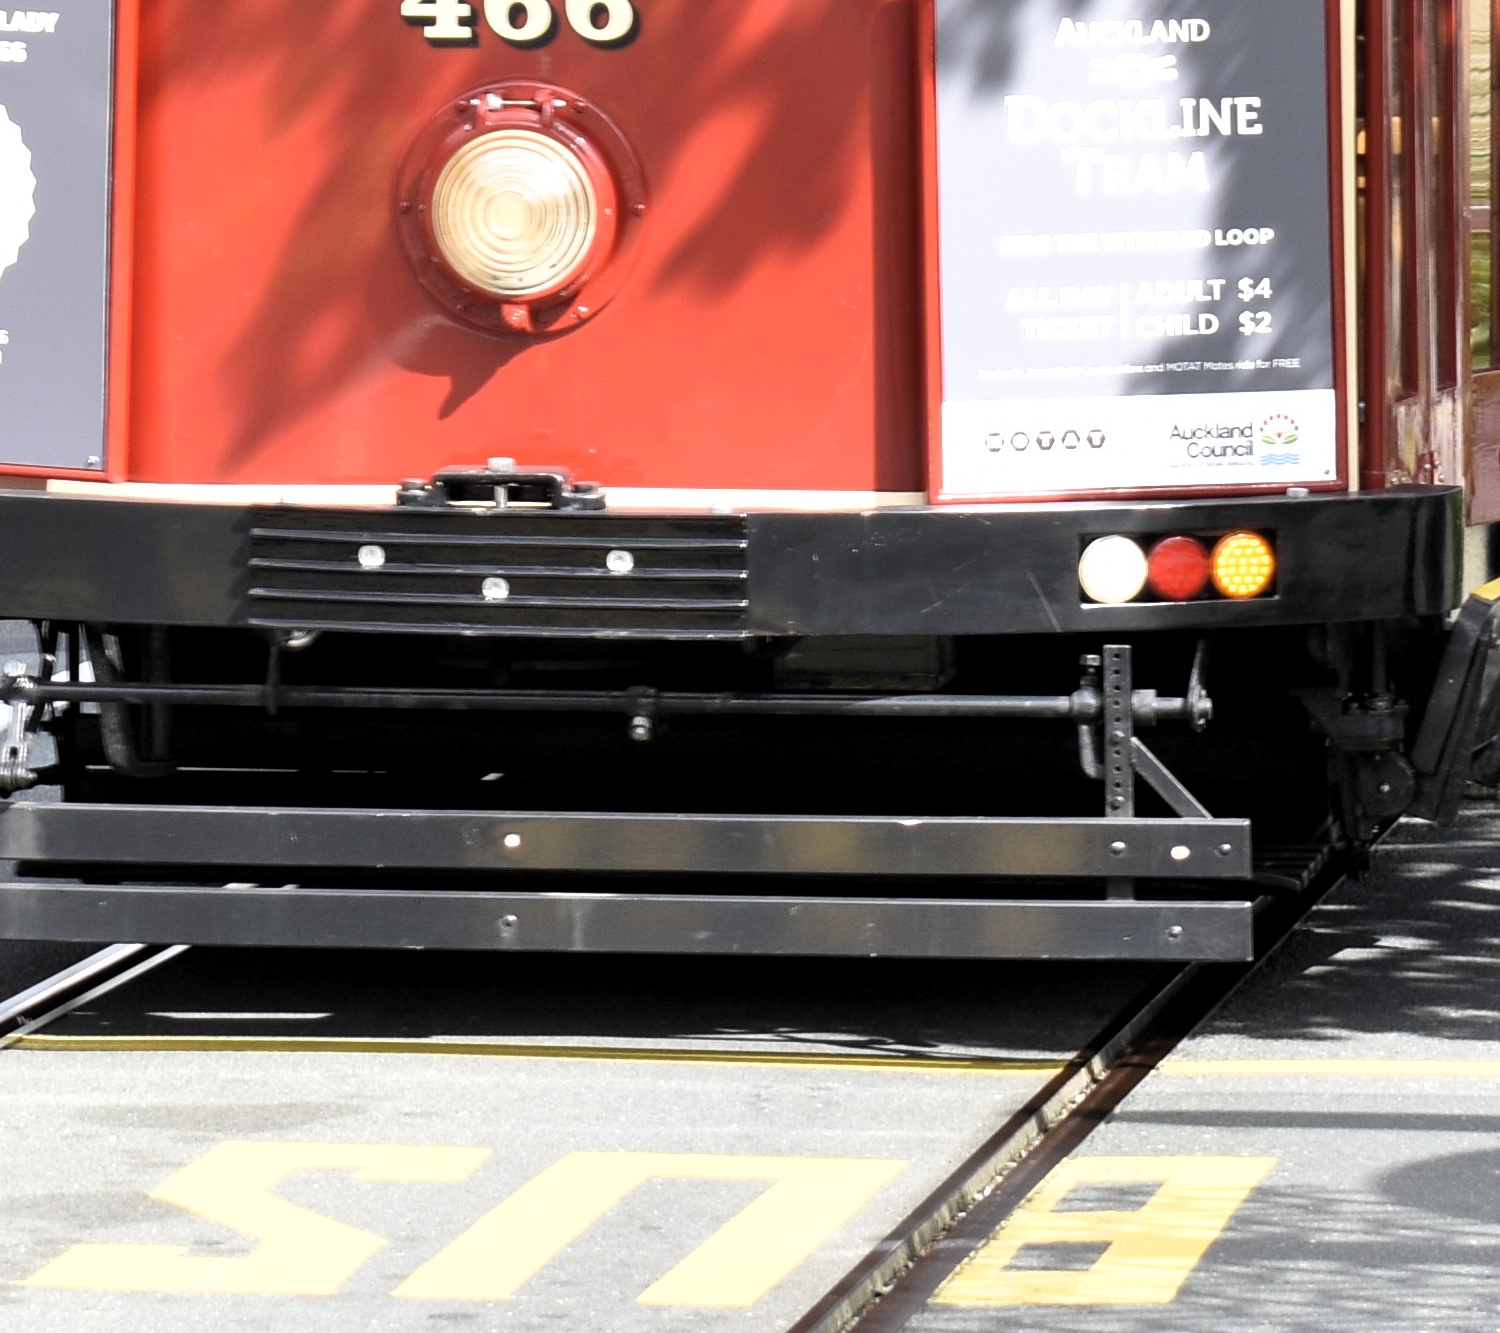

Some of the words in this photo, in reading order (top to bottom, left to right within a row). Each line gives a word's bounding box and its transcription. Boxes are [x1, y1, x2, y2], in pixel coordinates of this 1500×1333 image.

[1053, 17, 1211, 47] AUCKLAND
[1003, 95, 1263, 144] DOCKLINE
[1060, 147, 1210, 197] TRAM
[1214, 228, 1275, 247] LOOP
[1133, 278, 1226, 305] ADULT
[1237, 276, 1273, 302] $4
[1134, 313, 1220, 338] CHILD
[1238, 311, 1273, 336] $2
[1272, 358, 1301, 369] FREE
[1169, 422, 1254, 441] Auckland
[1187, 440, 1254, 459] Council
[11, 1139, 1279, 1308] BUS
